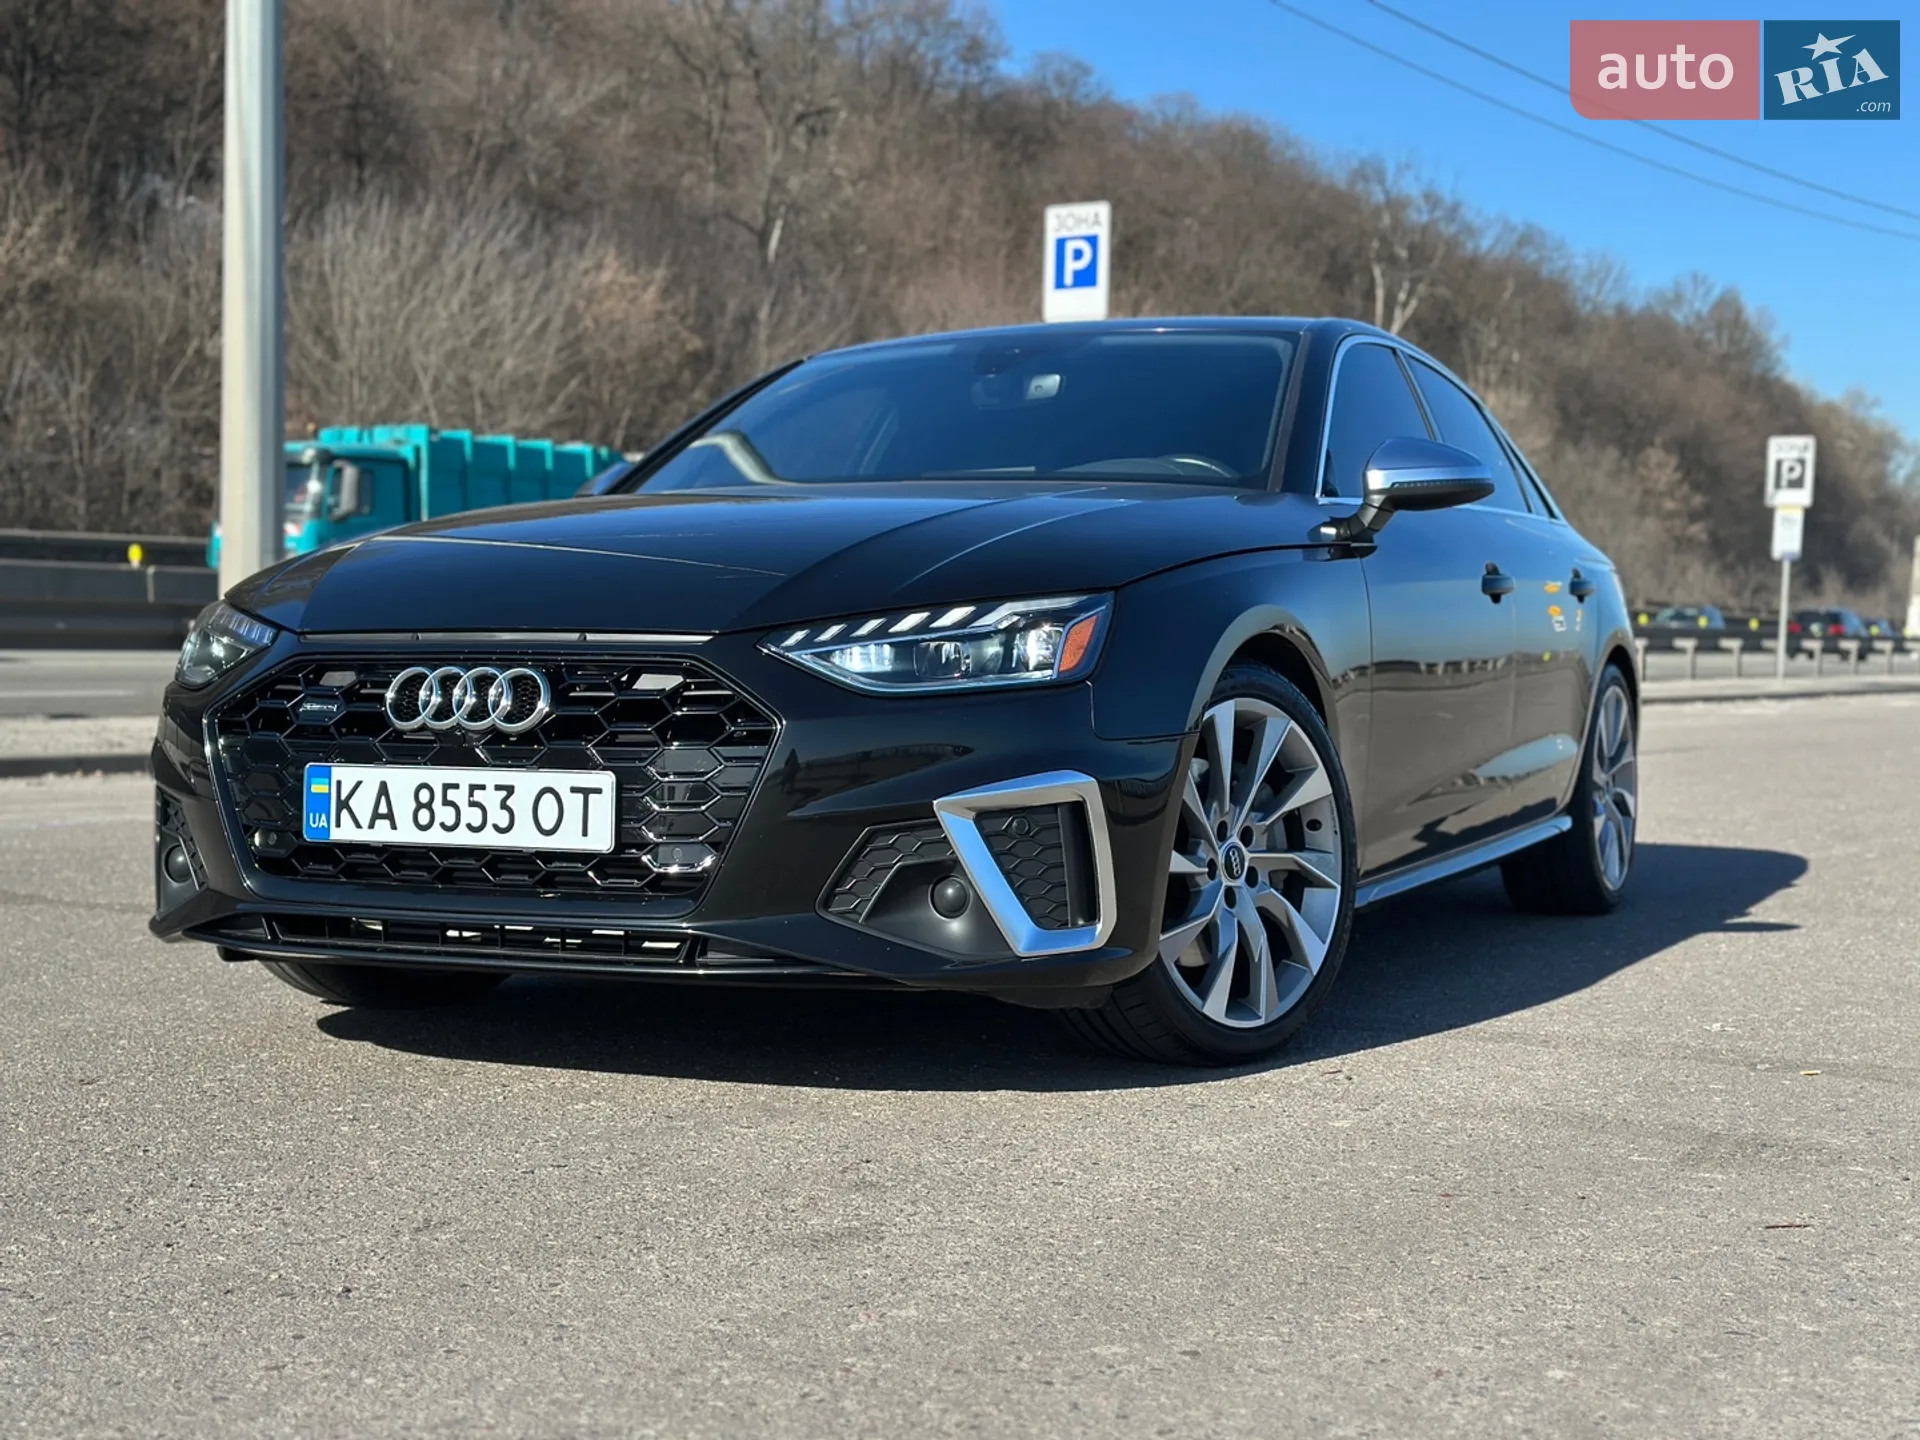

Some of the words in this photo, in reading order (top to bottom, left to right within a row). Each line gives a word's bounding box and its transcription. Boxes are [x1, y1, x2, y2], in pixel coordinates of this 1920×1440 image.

[1064, 238, 1093, 288] P
[1781, 459, 1803, 488] P
[309, 813, 328, 828] UA
[335, 779, 398, 831] KA
[412, 782, 516, 835] 8553
[532, 786, 603, 837] OT
